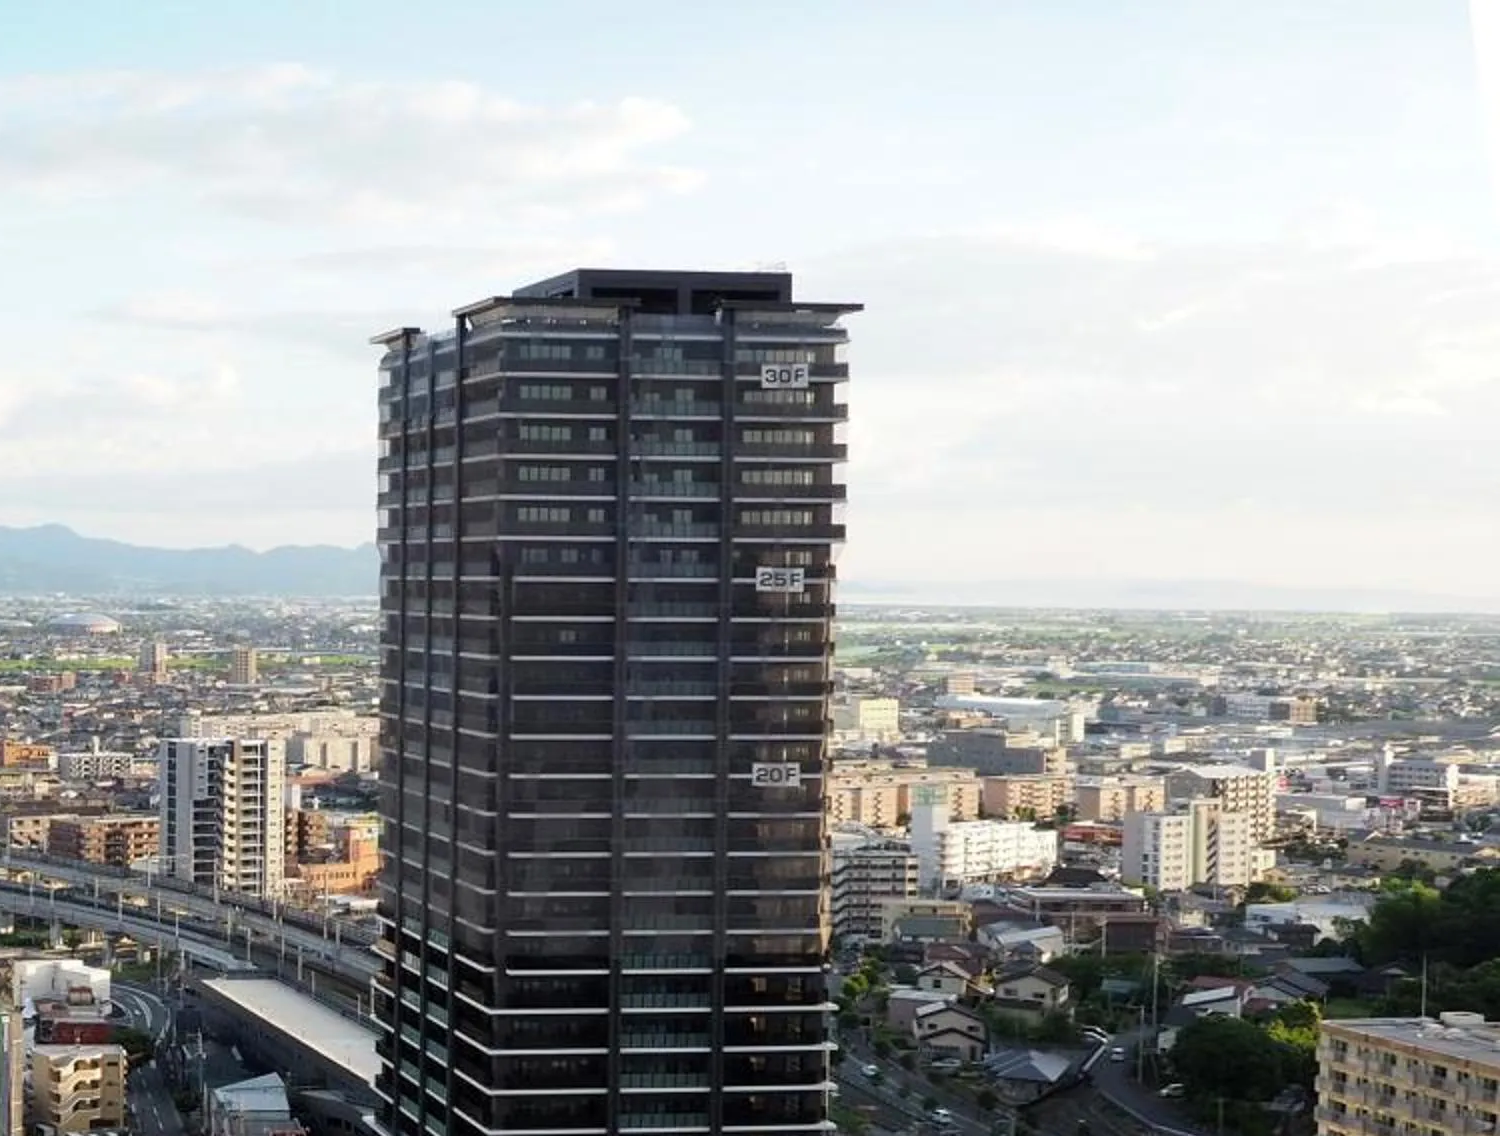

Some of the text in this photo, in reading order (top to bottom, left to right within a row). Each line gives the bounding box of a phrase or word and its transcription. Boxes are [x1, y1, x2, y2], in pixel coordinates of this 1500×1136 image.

[765, 368, 804, 383] 30F
[759, 572, 801, 587] 25F
[756, 767, 797, 783] 20F
